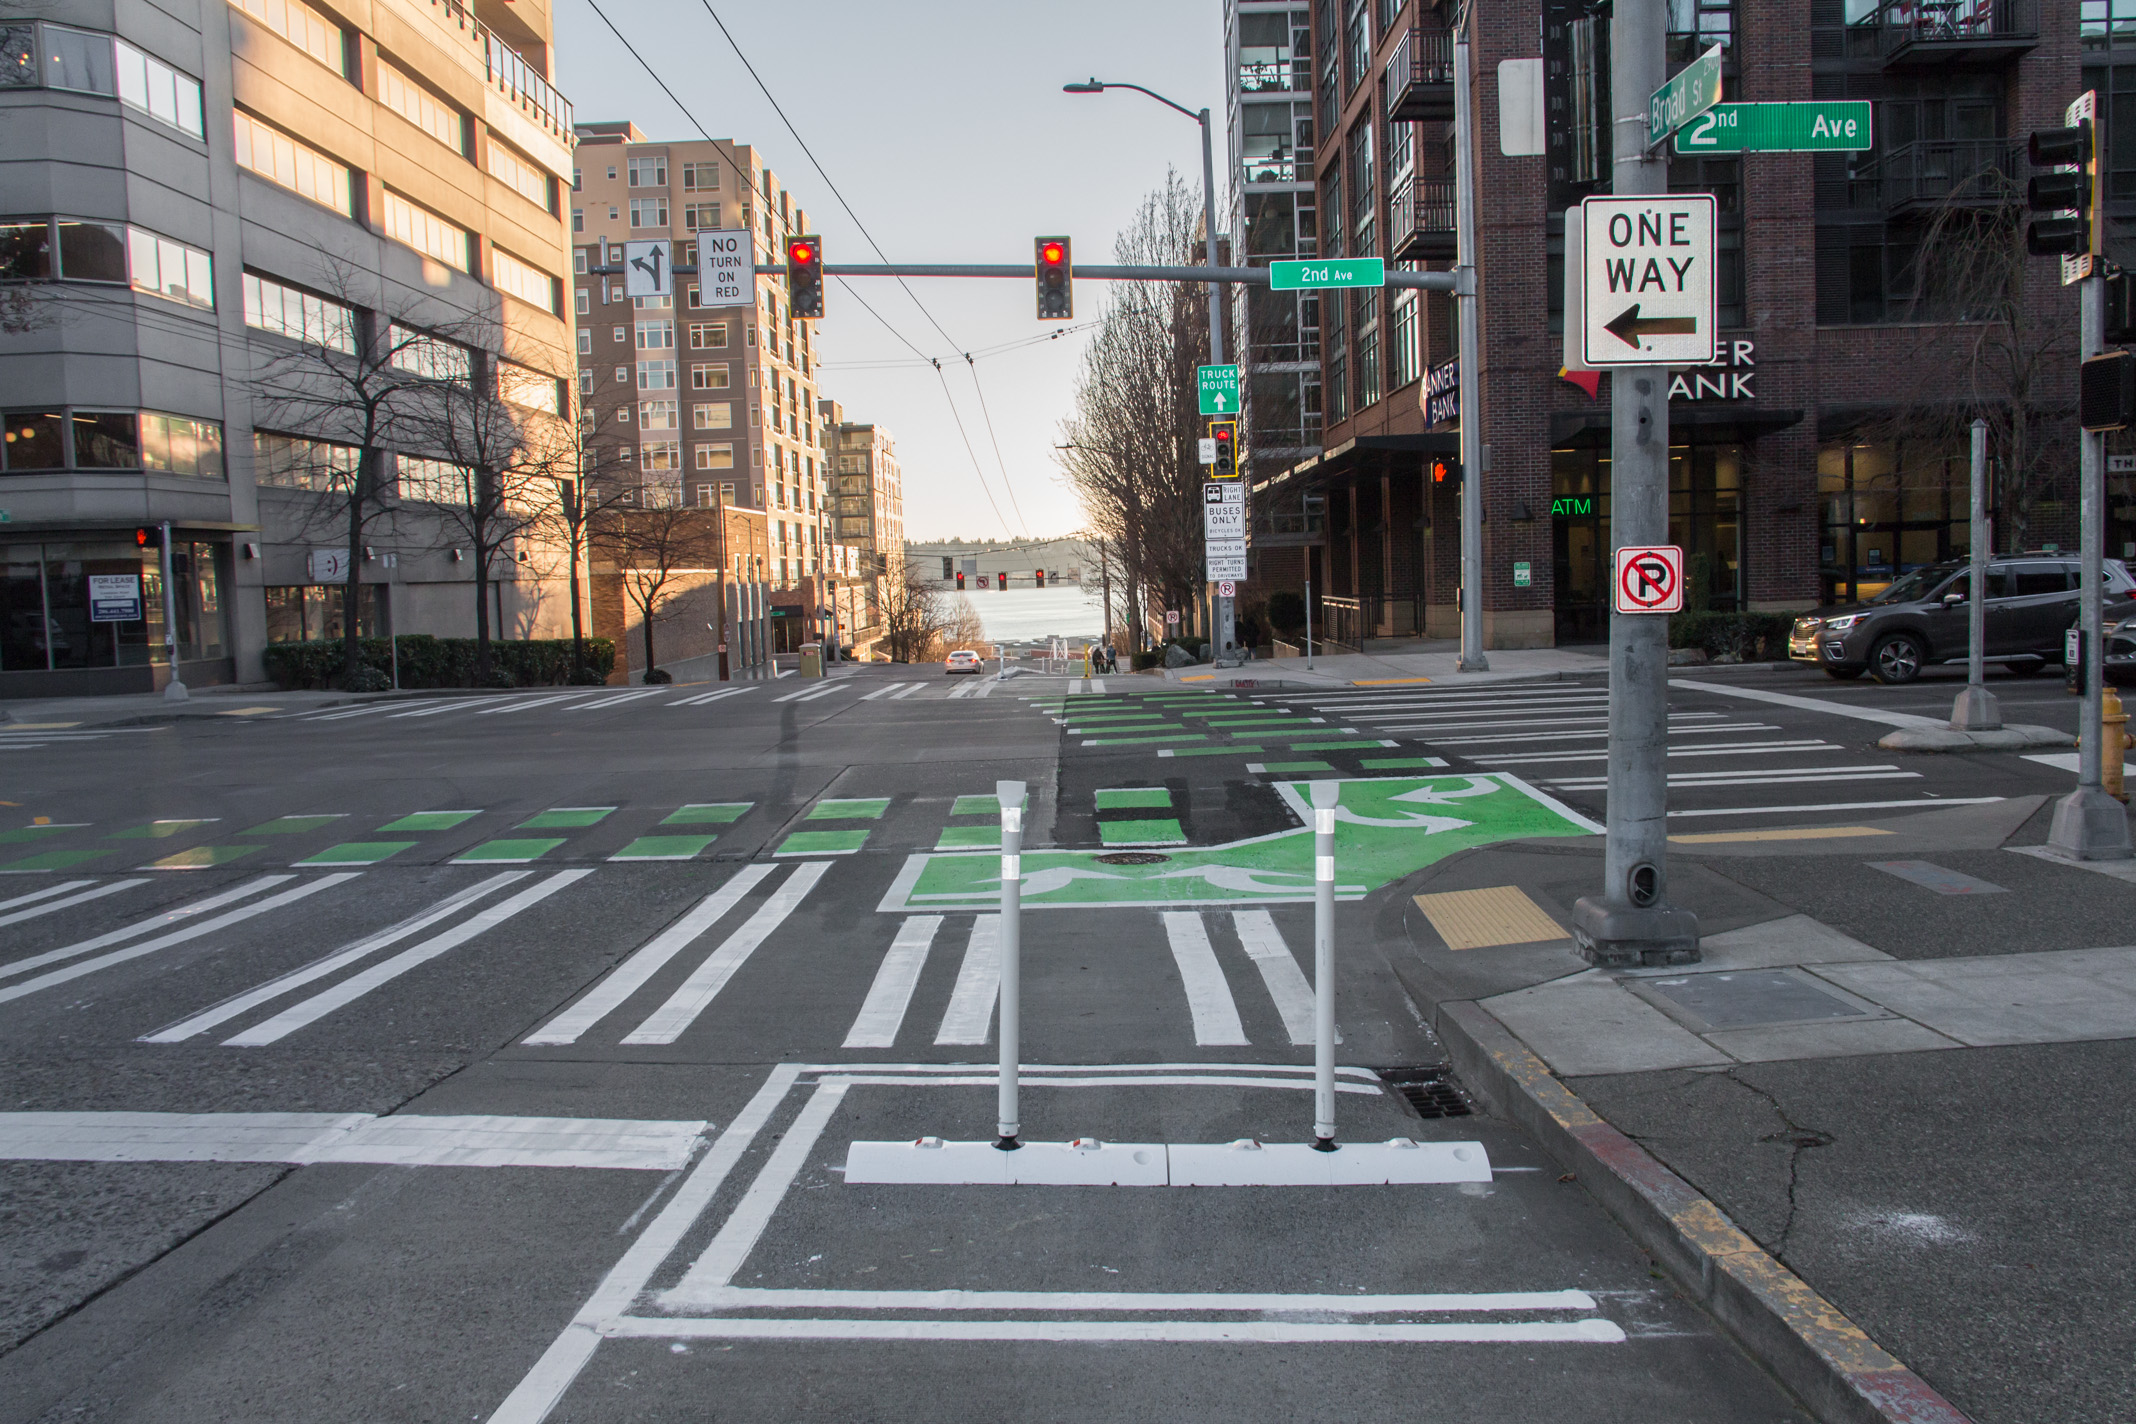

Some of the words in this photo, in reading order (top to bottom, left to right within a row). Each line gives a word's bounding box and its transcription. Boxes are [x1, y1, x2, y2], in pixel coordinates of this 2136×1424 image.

[1652, 78, 1686, 134] Broad
[1692, 78, 1703, 106] St
[1689, 110, 1738, 145] 2nd
[1811, 114, 1857, 138] Ave
[1608, 212, 1691, 248] ONE
[712, 238, 738, 253] NO
[709, 256, 742, 268] TURN
[718, 271, 735, 283] ON
[1301, 266, 1329, 282] 2nd
[1334, 269, 1353, 281] Ave
[1605, 256, 1695, 293] WAY
[715, 286, 740, 298] RED
[1200, 369, 1235, 379] TRUCK
[1202, 380, 1236, 390] ROUTE
[1422, 363, 1455, 400] BANNER
[1667, 373, 1755, 400] ANK
[1432, 391, 1456, 424] BANK
[2113, 459, 2136, 469] TH
[1223, 486, 1241, 494] RIGHT
[1224, 493, 1241, 501] LANE
[1209, 506, 1241, 516] BUSES
[1551, 498, 1591, 515] ATM
[1212, 516, 1238, 524] ONLY
[93, 577, 109, 585] FOR
[110, 576, 136, 584] LEASE
